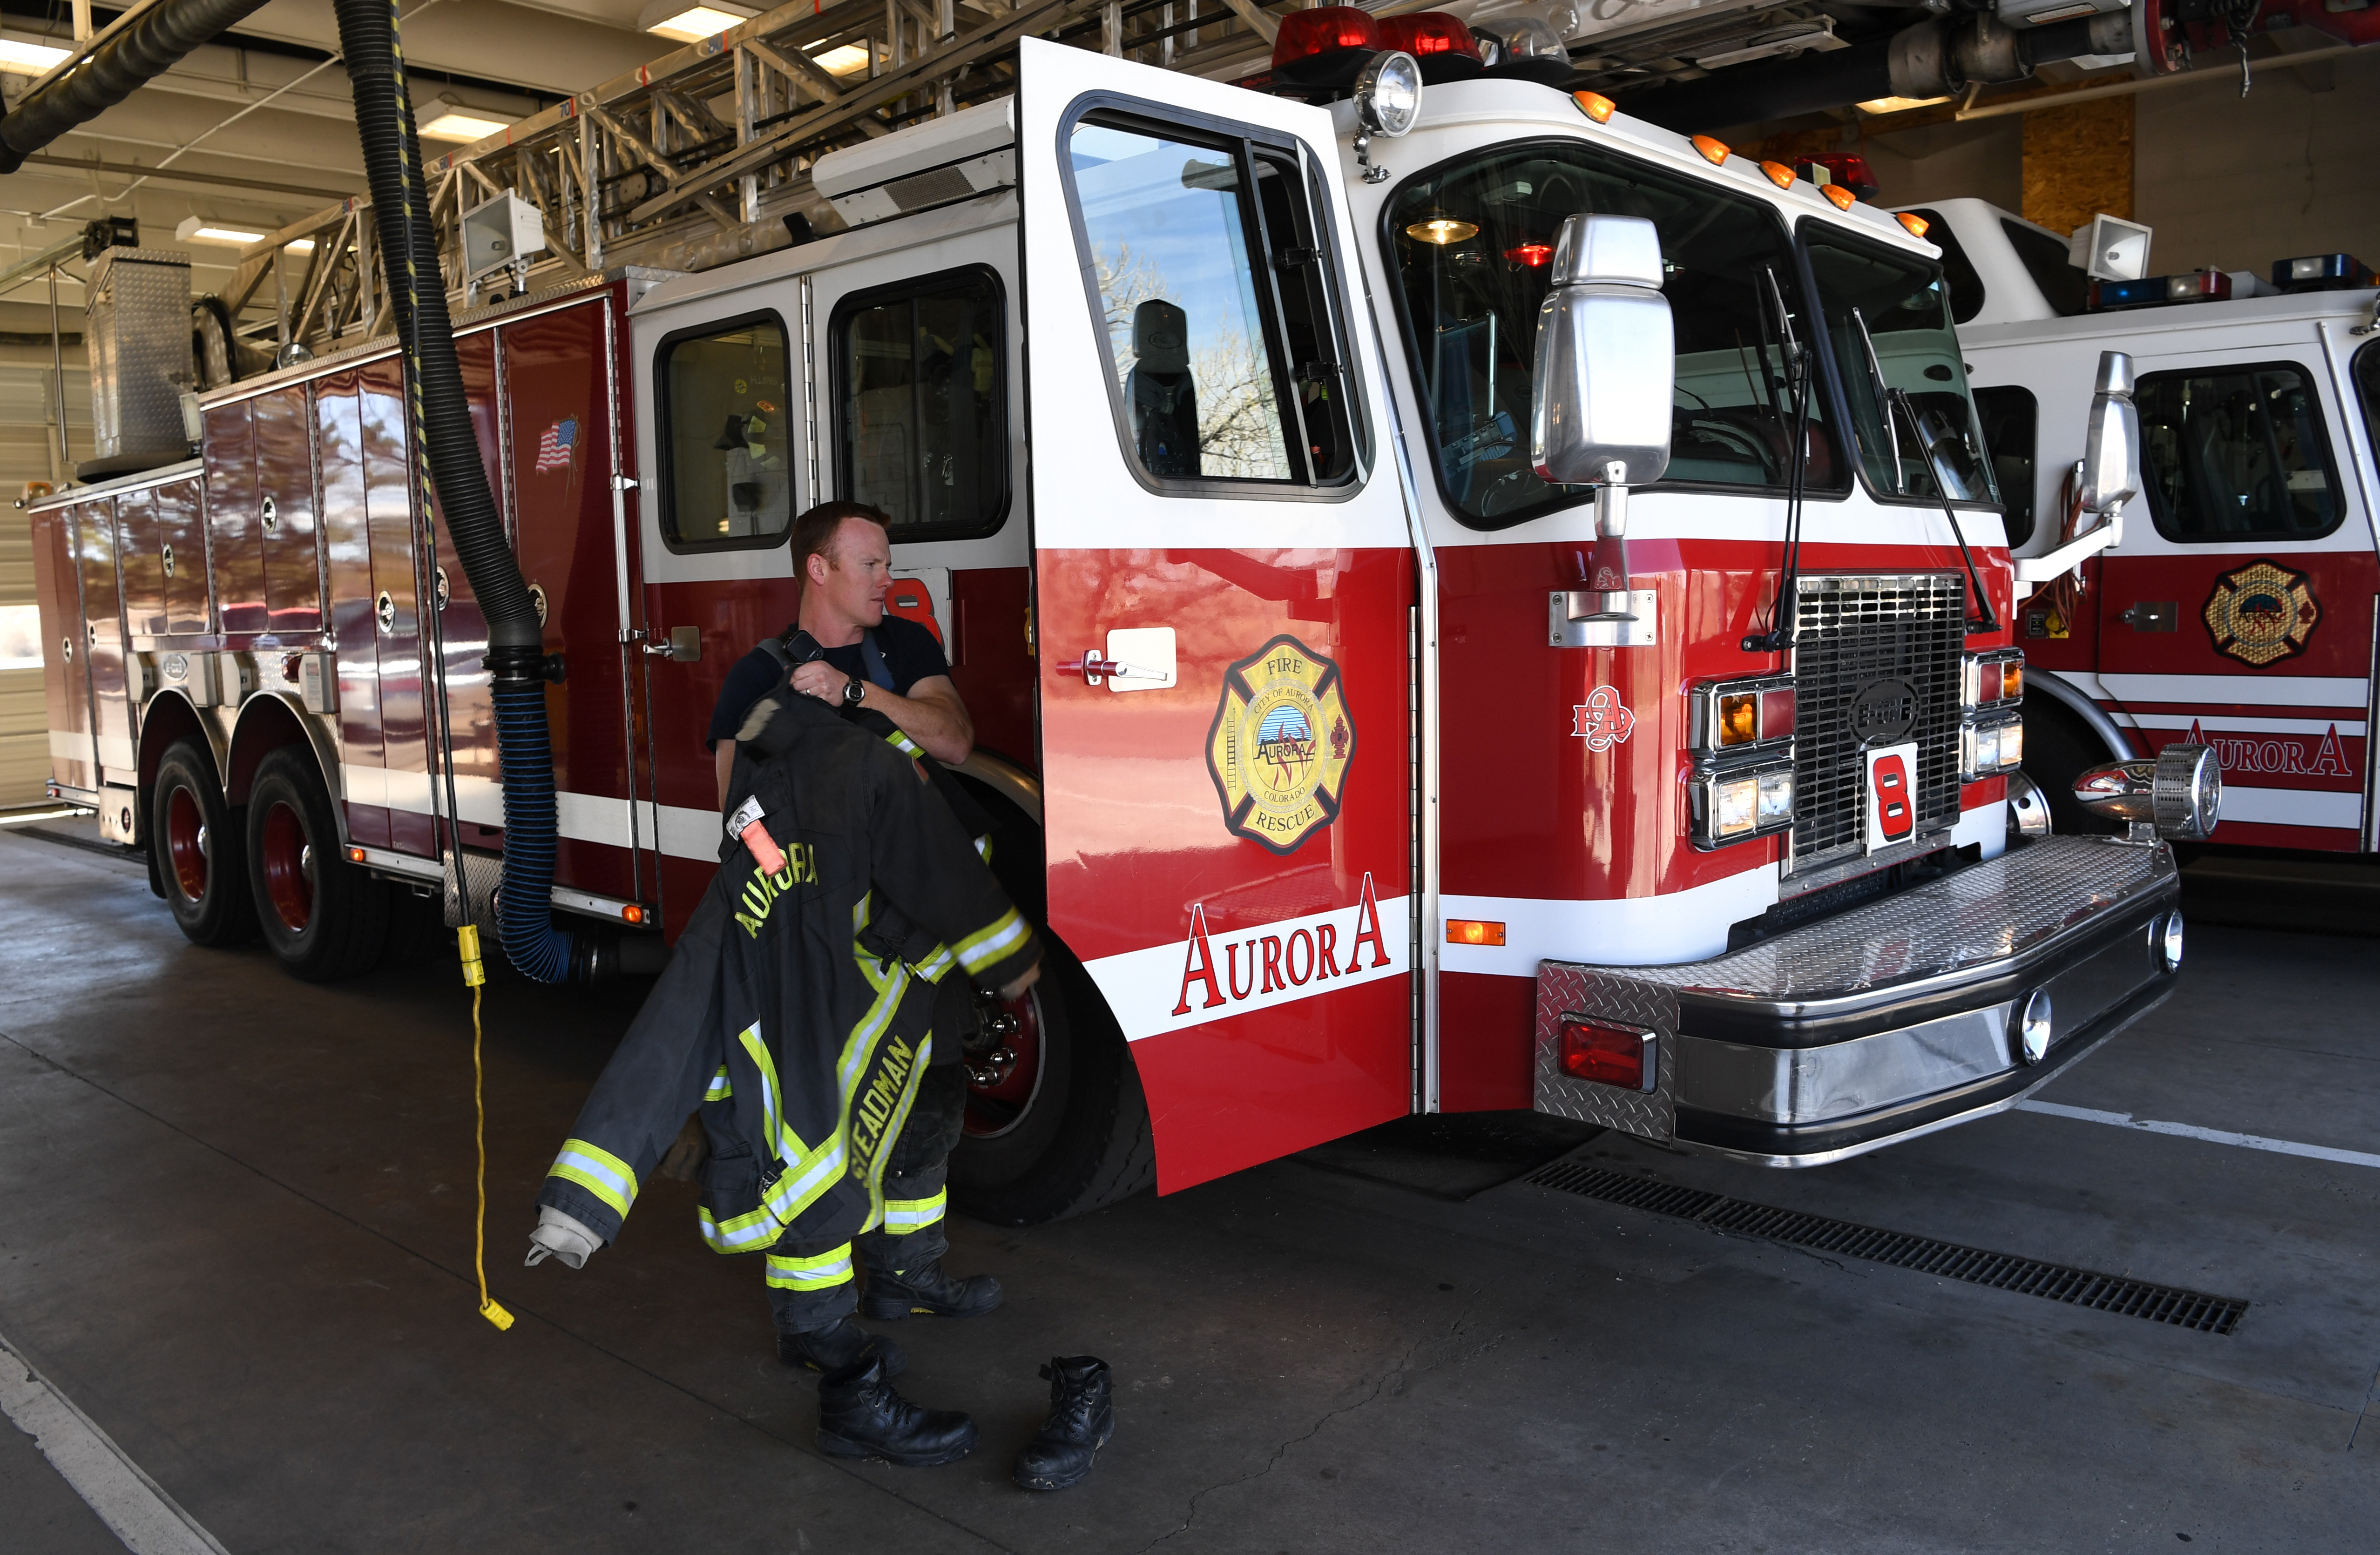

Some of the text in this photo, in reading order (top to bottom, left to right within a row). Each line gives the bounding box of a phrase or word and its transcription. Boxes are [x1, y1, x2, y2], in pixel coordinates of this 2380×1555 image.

[560, 101, 571, 119] 70
[1266, 658, 1303, 676] FIRE
[1254, 688, 1313, 715] CITY OF AURORA
[1257, 744, 1305, 761] AURORA
[1264, 787, 1305, 803] COLORADO
[1873, 754, 1913, 842] 8
[1255, 804, 1315, 832] RESCUE
[1171, 871, 1391, 1017] AURORA
